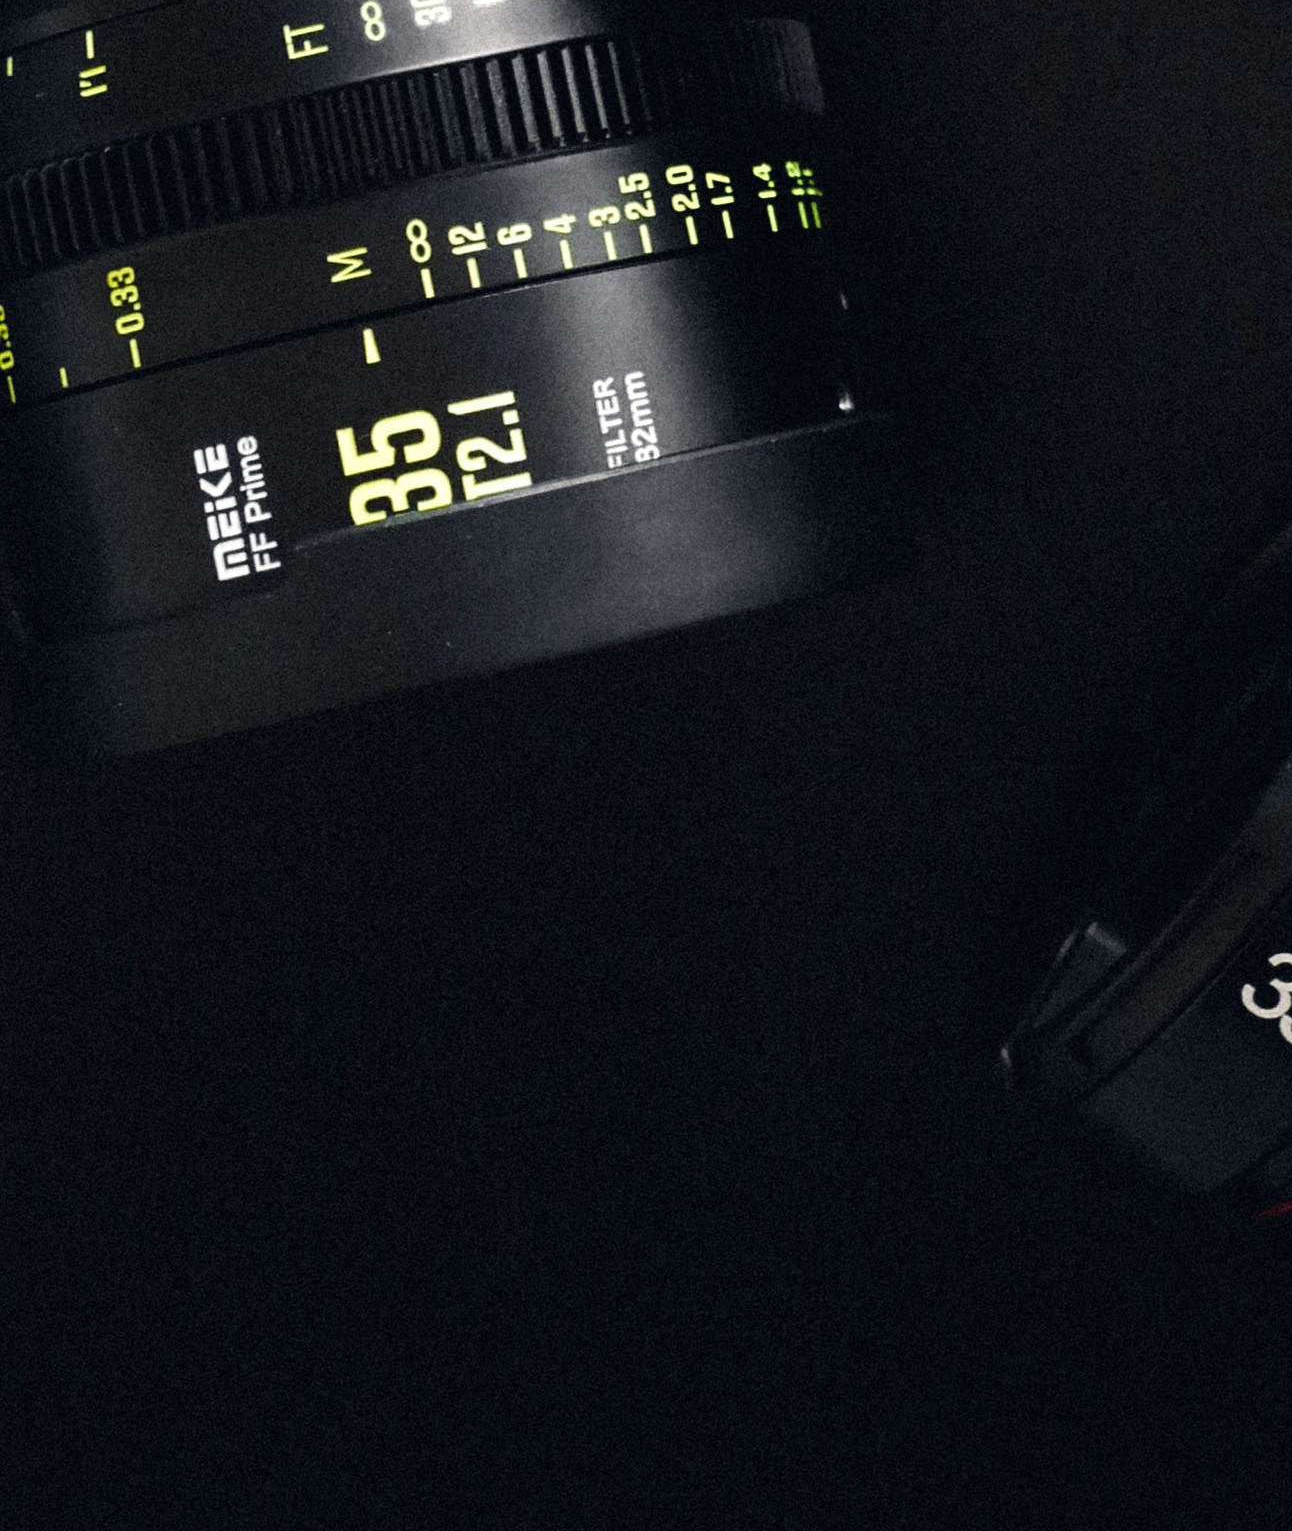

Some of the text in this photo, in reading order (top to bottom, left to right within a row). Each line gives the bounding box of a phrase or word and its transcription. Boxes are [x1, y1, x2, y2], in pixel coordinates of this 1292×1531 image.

[283, 23, 329, 60] FT
[618, 171, 656, 220] 2.5
[665, 164, 701, 212] 2.0
[705, 172, 735, 206] 1.7
[752, 163, 777, 199] 1.4
[496, 222, 533, 246] 6
[543, 213, 577, 234] 4
[587, 205, 621, 228] 3
[447, 221, 488, 256] 12
[326, 247, 372, 283] M
[107, 266, 145, 335] 0.33
[593, 376, 623, 468] FILTER
[446, 390, 533, 502] T2.1
[335, 409, 454, 526] 35
[236, 435, 282, 573] FF Prime
